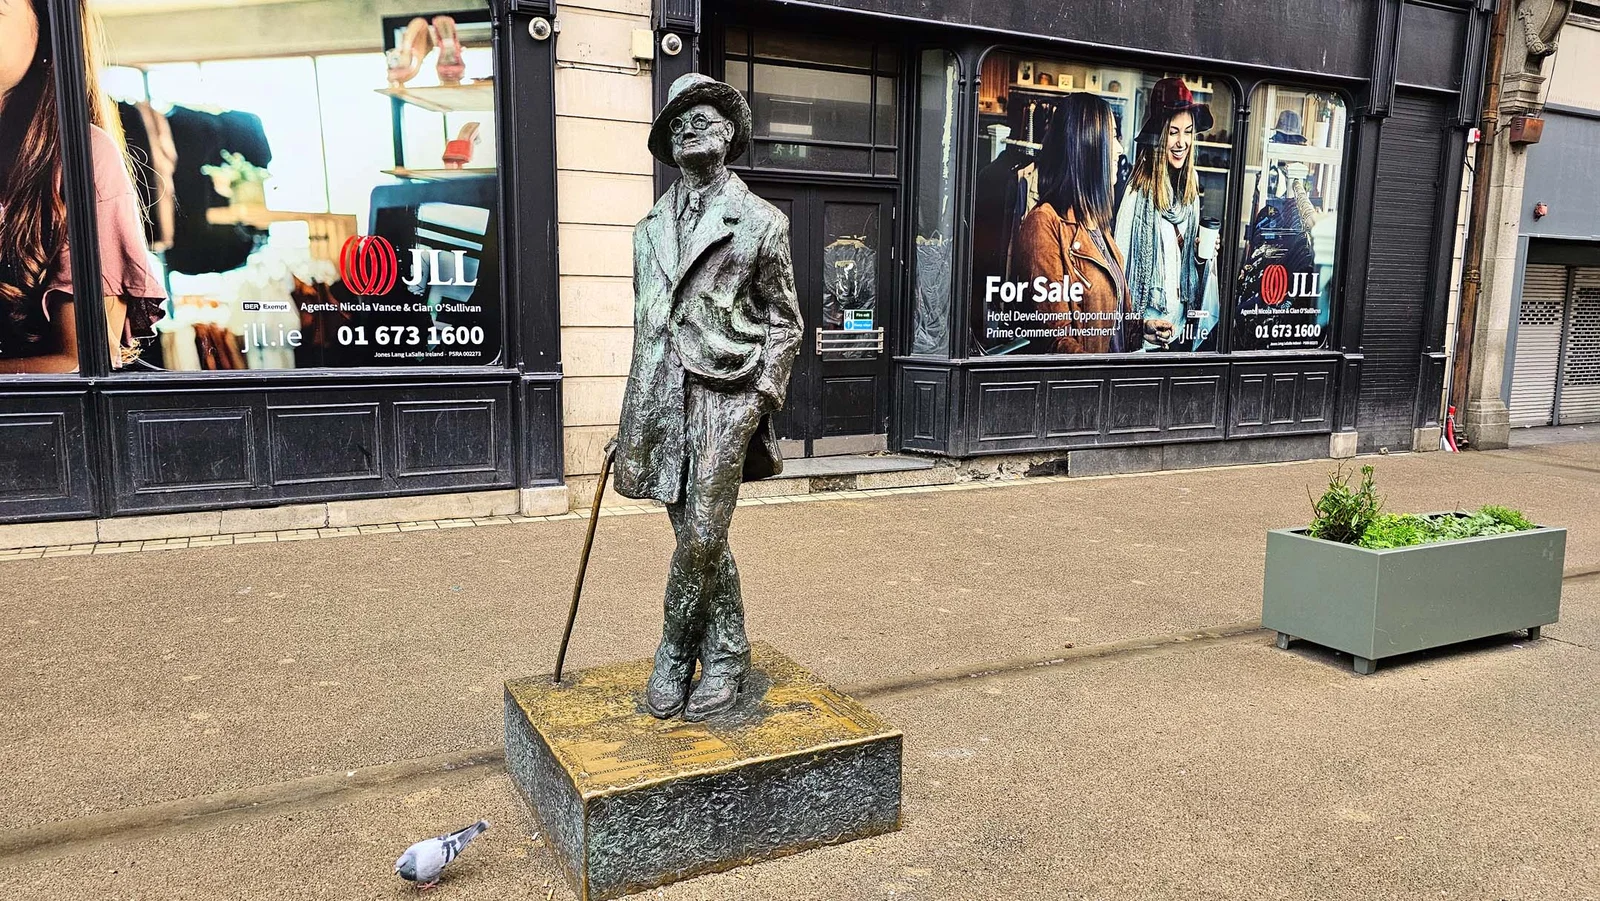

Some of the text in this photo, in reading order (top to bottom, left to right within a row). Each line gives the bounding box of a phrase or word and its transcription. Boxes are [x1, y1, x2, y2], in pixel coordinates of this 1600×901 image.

[401, 248, 478, 286] JLL
[985, 274, 1084, 303] For Sale
[1287, 272, 1322, 298] JLL
[262, 303, 288, 311] Exempt
[300, 302, 338, 313] Agents:
[339, 302, 371, 312] Nicola
[372, 302, 402, 312] Vance
[403, 303, 411, 312] &
[412, 303, 433, 312] Cian
[987, 309, 1141, 323] Hotel Development Opportunity and
[241, 322, 303, 354] jll.ie
[337, 325, 485, 346] 01 673 1600
[986, 326, 1116, 339] Prime Commercial Investment
[1180, 323, 1209, 345] jll.ie
[1255, 324, 1321, 339] 01 673 1600
